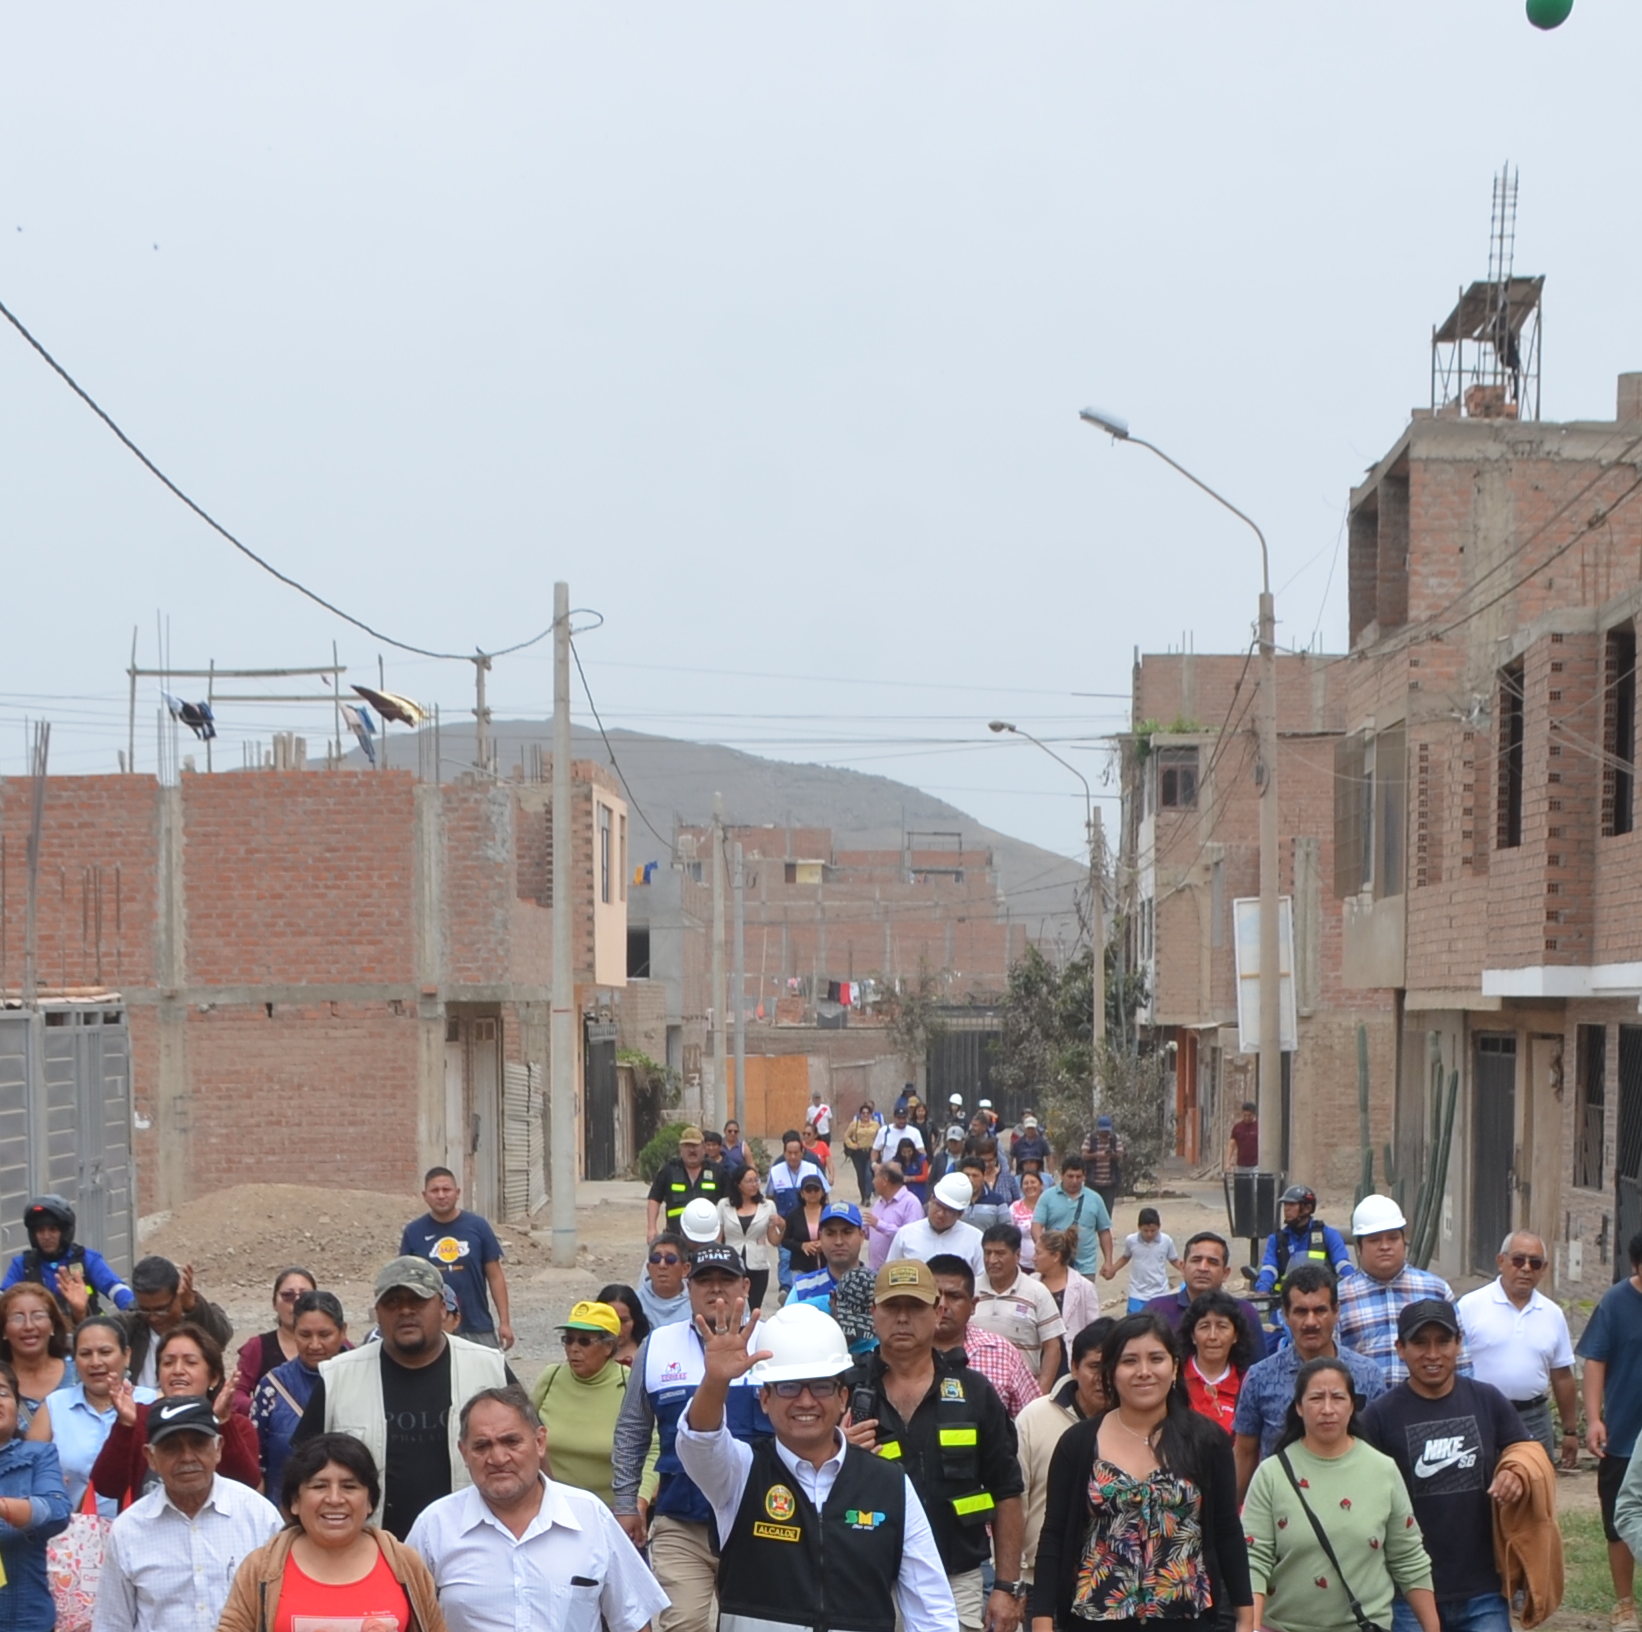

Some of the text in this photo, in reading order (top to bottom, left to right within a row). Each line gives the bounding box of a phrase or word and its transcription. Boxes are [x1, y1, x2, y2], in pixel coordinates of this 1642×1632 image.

[1423, 1435, 1465, 1462] NIKE
[1457, 1453, 1477, 1469] SB
[844, 1509, 886, 1527] SMP
[758, 1525, 797, 1540] ALCALDE
